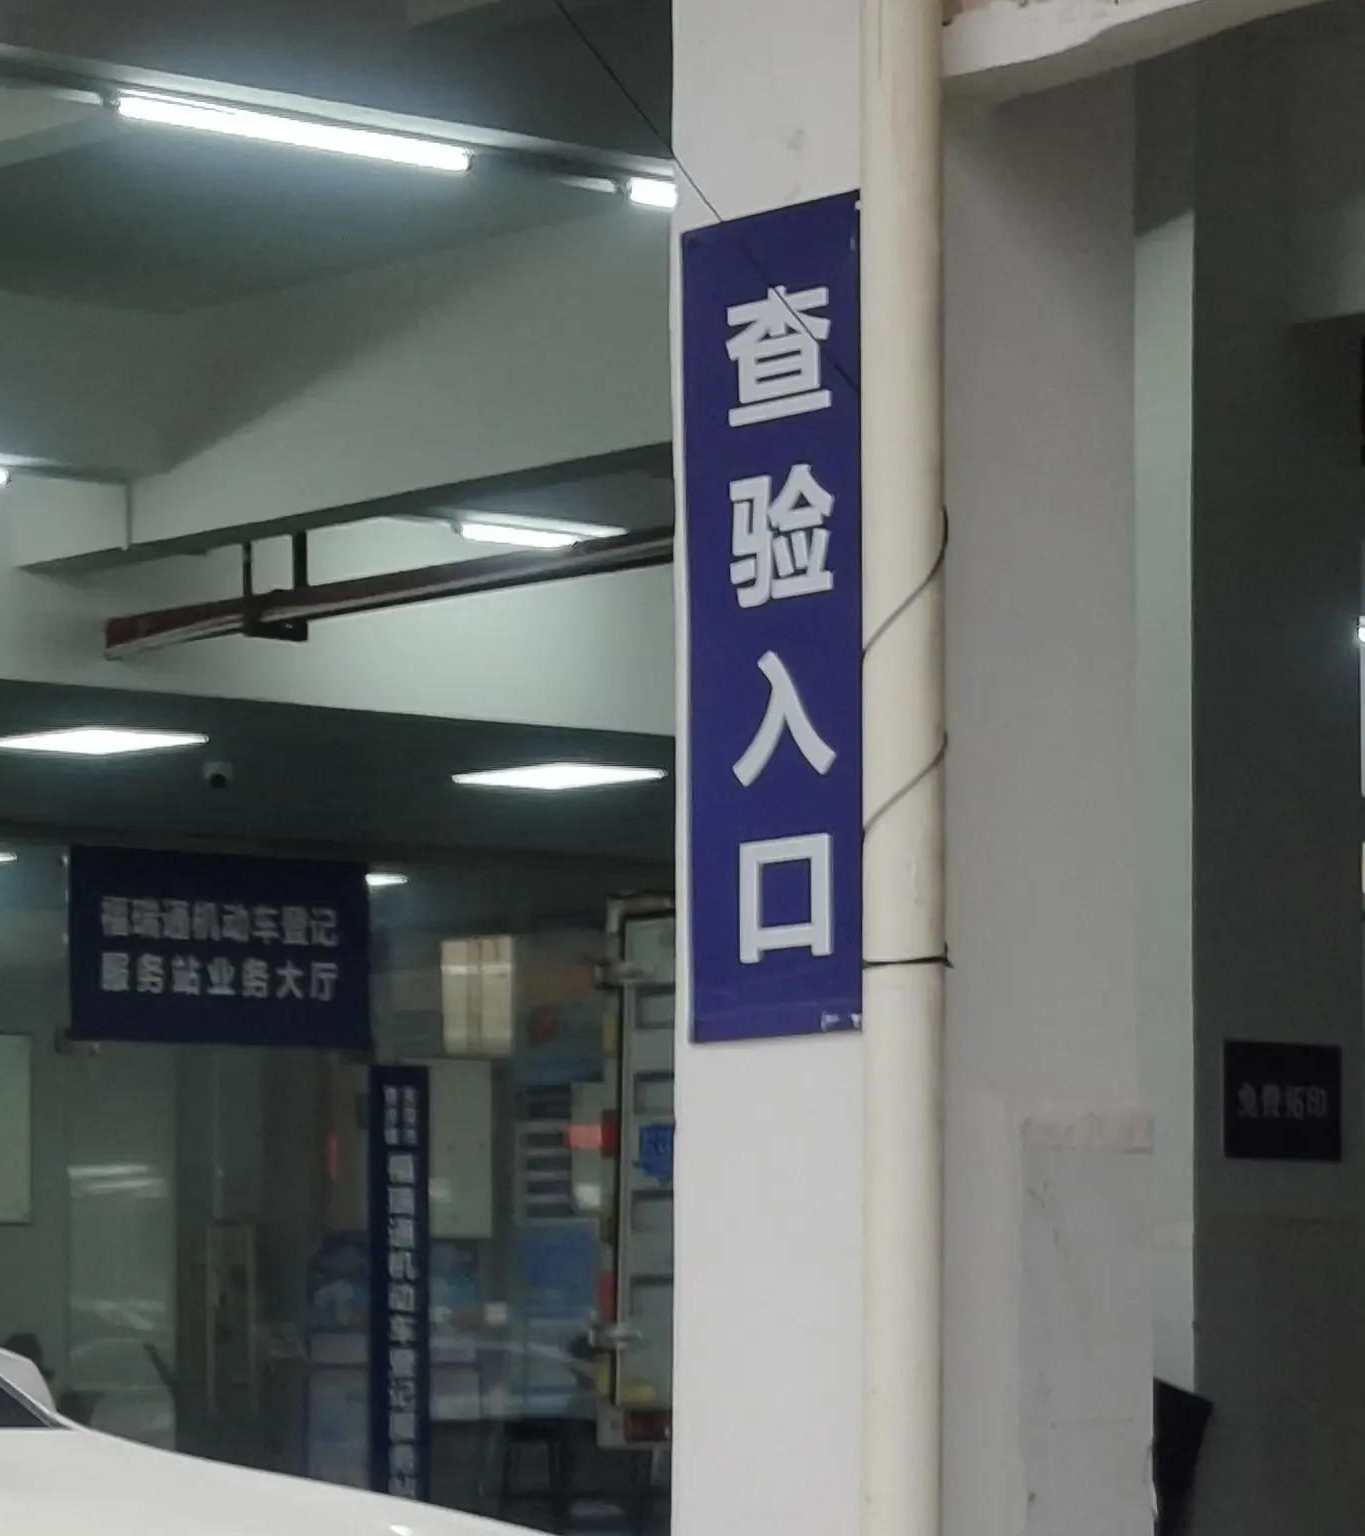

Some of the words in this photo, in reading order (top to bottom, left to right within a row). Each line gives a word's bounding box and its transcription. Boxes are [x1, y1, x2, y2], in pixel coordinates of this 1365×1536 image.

[726, 285, 836, 964] 查验入口
[100, 951, 339, 1002] 服务站业务大厅
